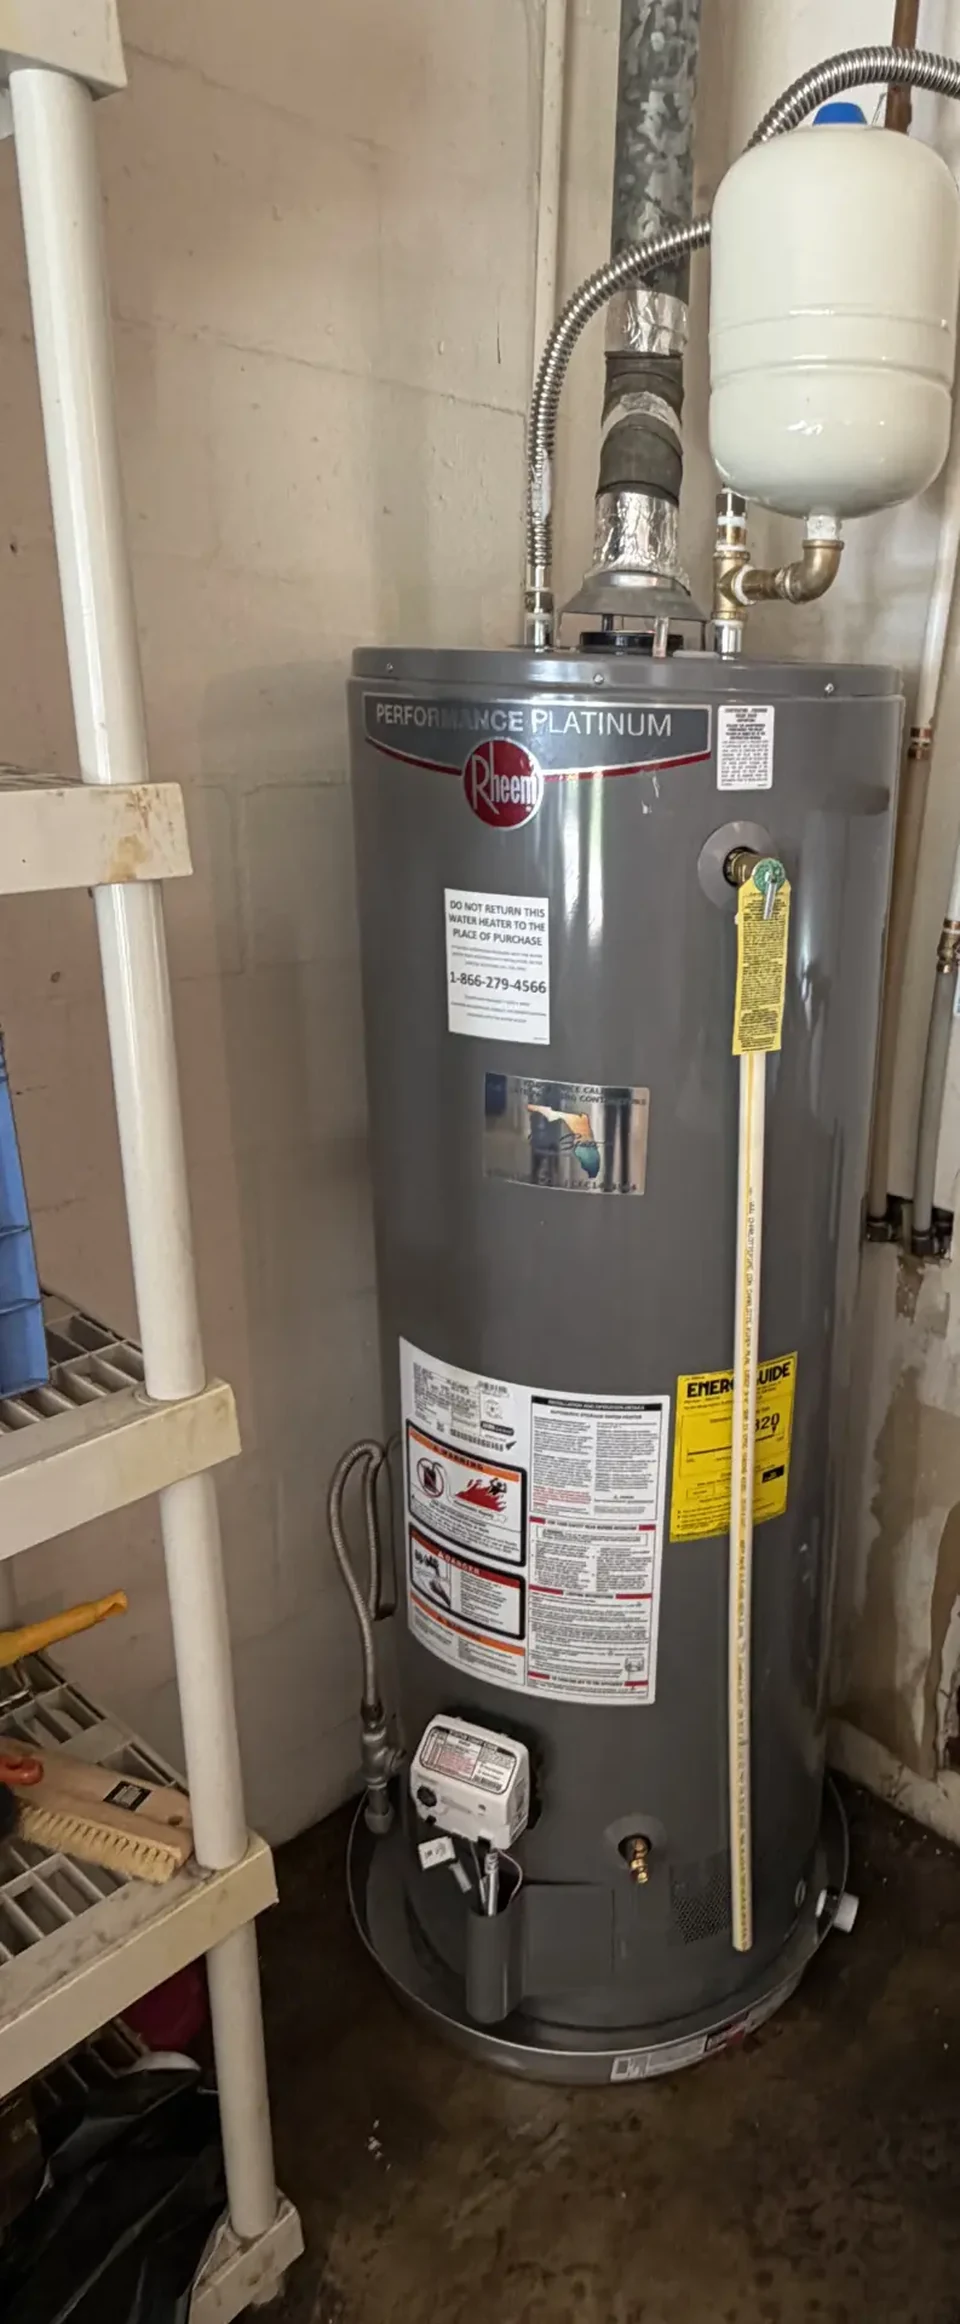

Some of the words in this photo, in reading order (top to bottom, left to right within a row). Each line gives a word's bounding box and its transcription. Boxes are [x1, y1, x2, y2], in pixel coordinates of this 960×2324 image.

[531, 712, 673, 737] PLATINUM
[471, 741, 540, 814] Rheem
[450, 900, 462, 910] DO
[464, 902, 482, 913] NOT
[485, 904, 521, 916] RETURN
[525, 907, 546, 918] THIS
[449, 914, 477, 925] WATER
[479, 917, 512, 929] HEATER
[514, 920, 527, 931] TO
[529, 922, 546, 932] THE
[453, 928, 477, 940] PLACE
[479, 931, 491, 941] OF
[493, 933, 543, 947] PURCHASE
[450, 971, 547, 994] 1-866-279-4566
